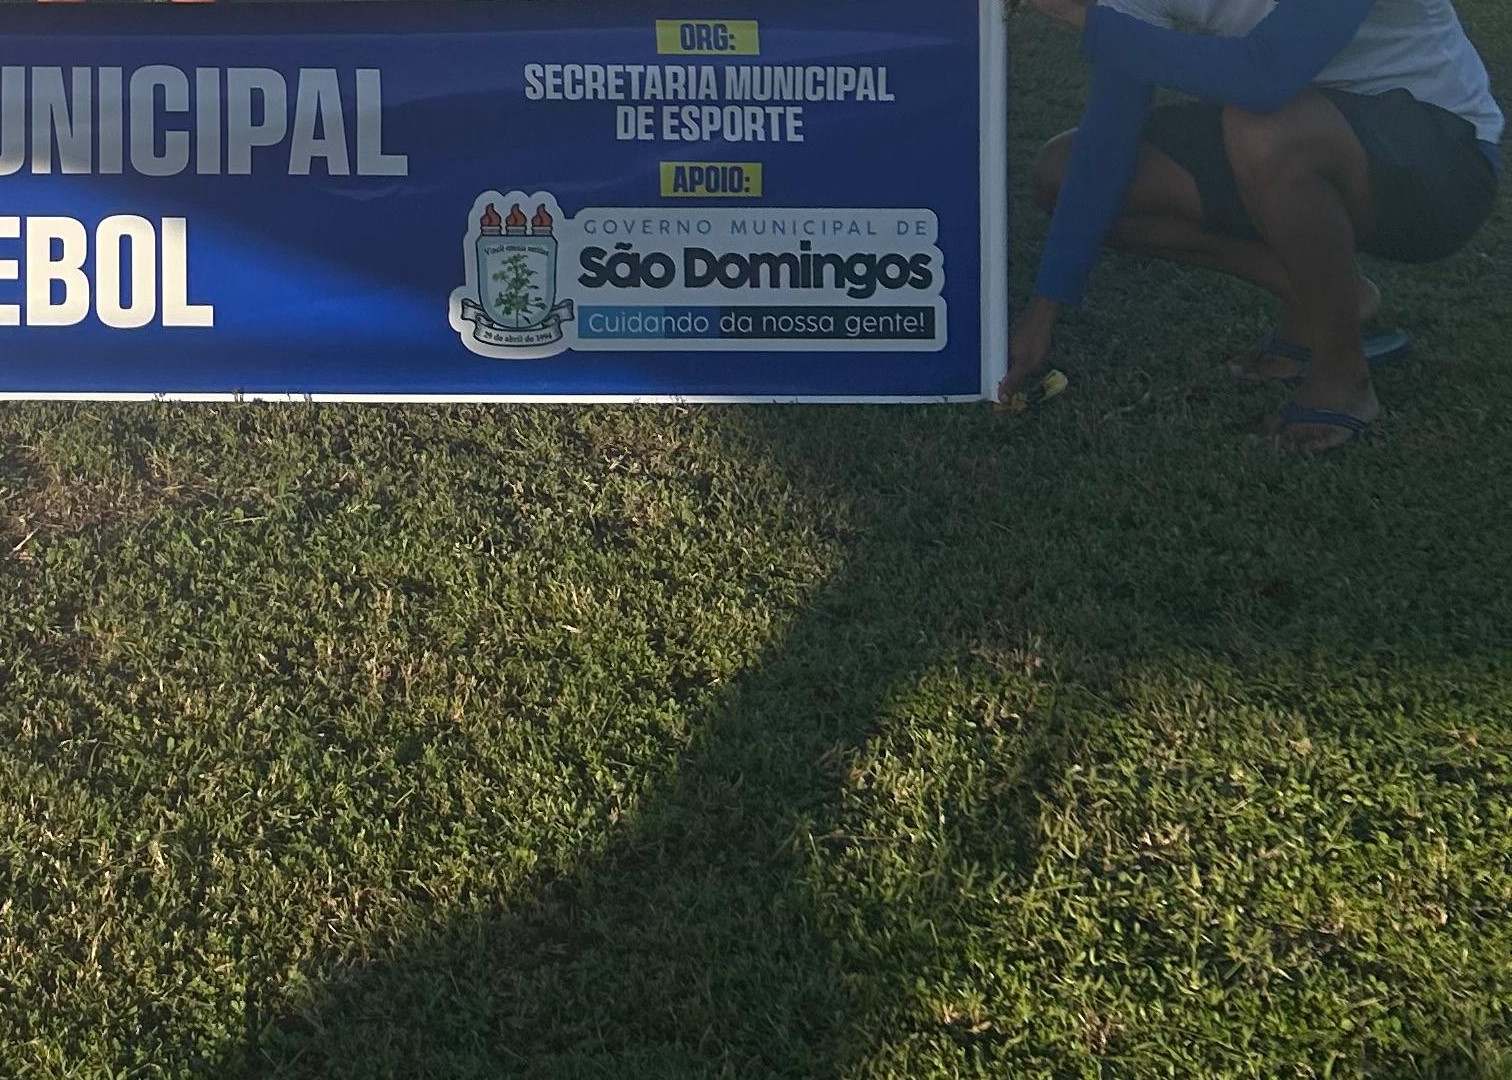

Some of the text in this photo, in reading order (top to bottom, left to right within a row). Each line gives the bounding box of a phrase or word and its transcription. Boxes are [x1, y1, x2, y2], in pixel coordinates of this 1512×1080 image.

[679, 23, 736, 52] ORG:
[524, 63, 896, 102] SECRETARIA MUNICIPAL
[616, 105, 805, 142] DE ESPORTE
[672, 165, 751, 194] APOIO:
[584, 219, 927, 237] GOVERNO MUNICIPAL DE
[577, 240, 934, 300] São Domingos
[588, 312, 925, 338] Cuidando da nossa gente!
